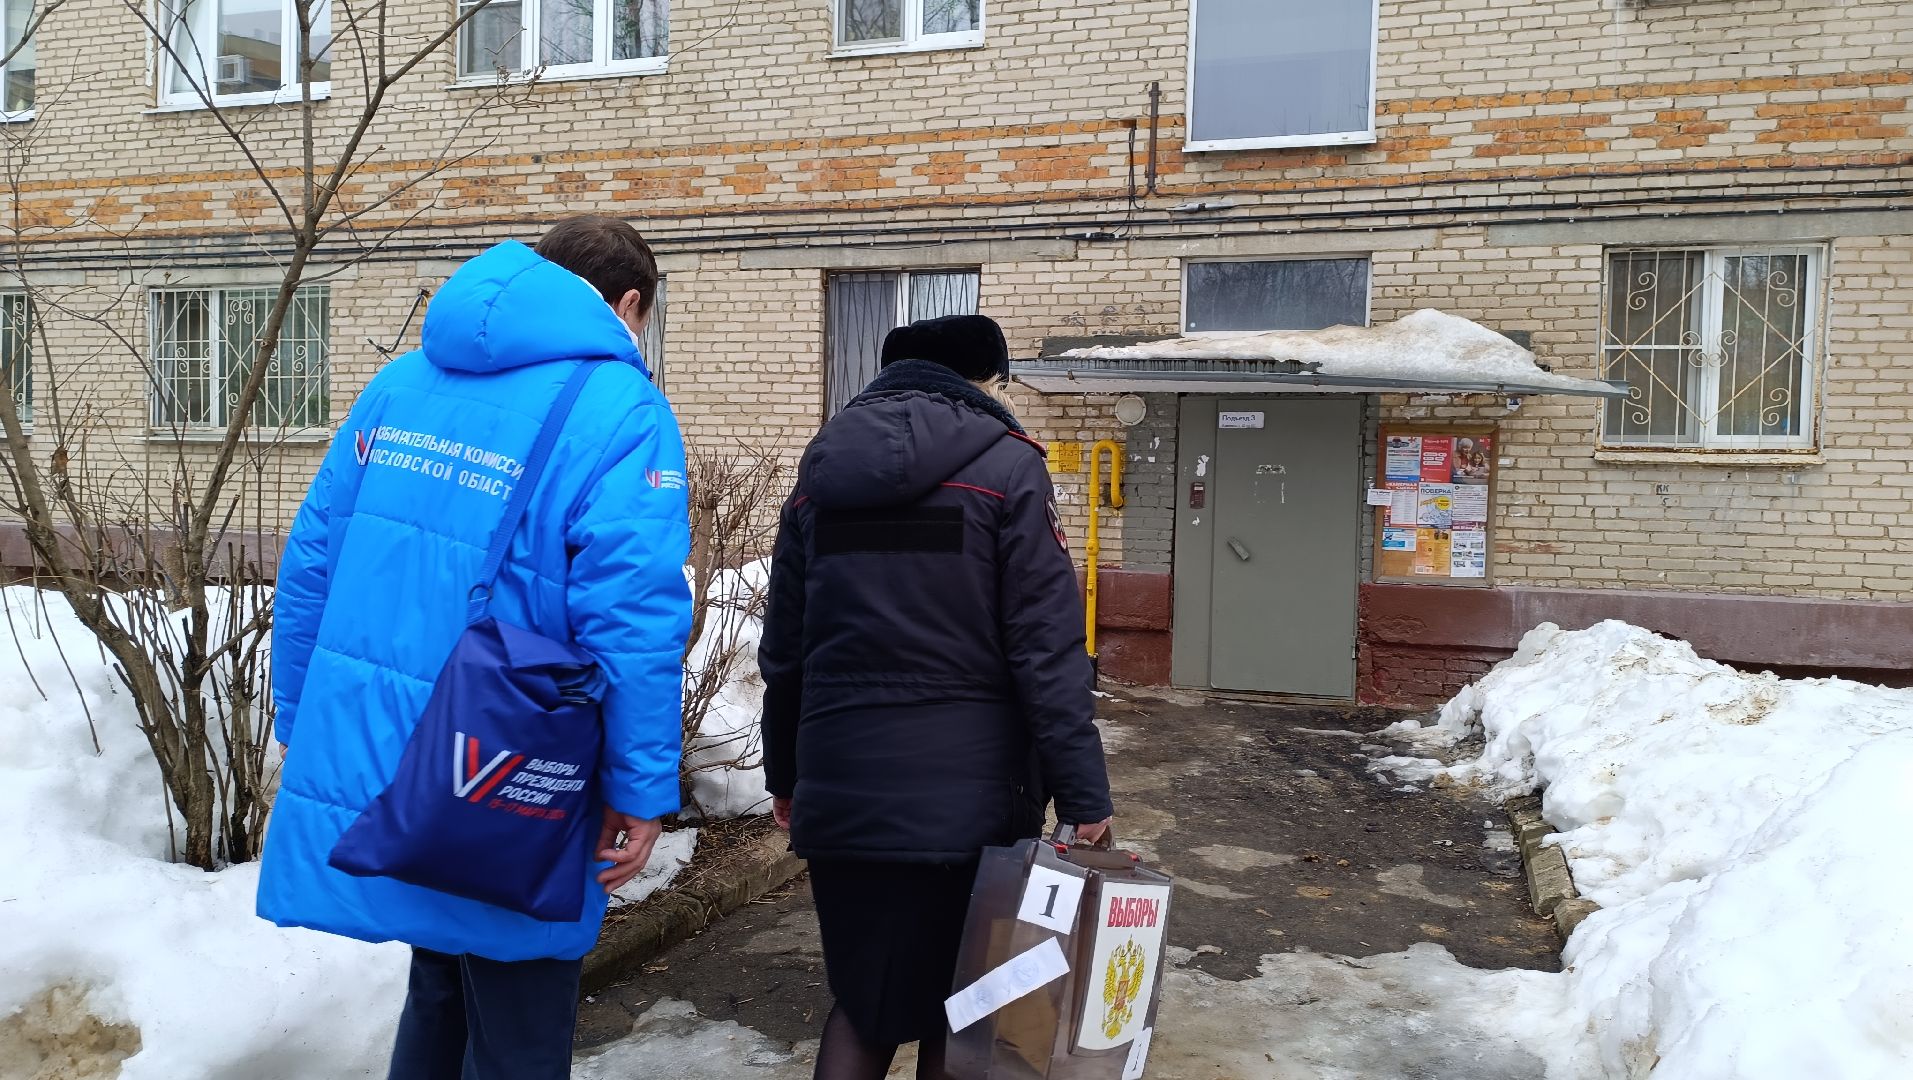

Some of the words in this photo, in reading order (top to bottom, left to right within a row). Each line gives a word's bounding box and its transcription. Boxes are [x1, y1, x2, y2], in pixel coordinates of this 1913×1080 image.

[463, 445, 526, 481] КОМИССИ
[458, 470, 513, 501] ОБЛАСТ
[524, 758, 580, 776] ВЫБОРЫ
[497, 785, 555, 805] РОССИИ
[1038, 884, 1060, 919] 1
[1107, 896, 1160, 928] ВЫБОРЫ
